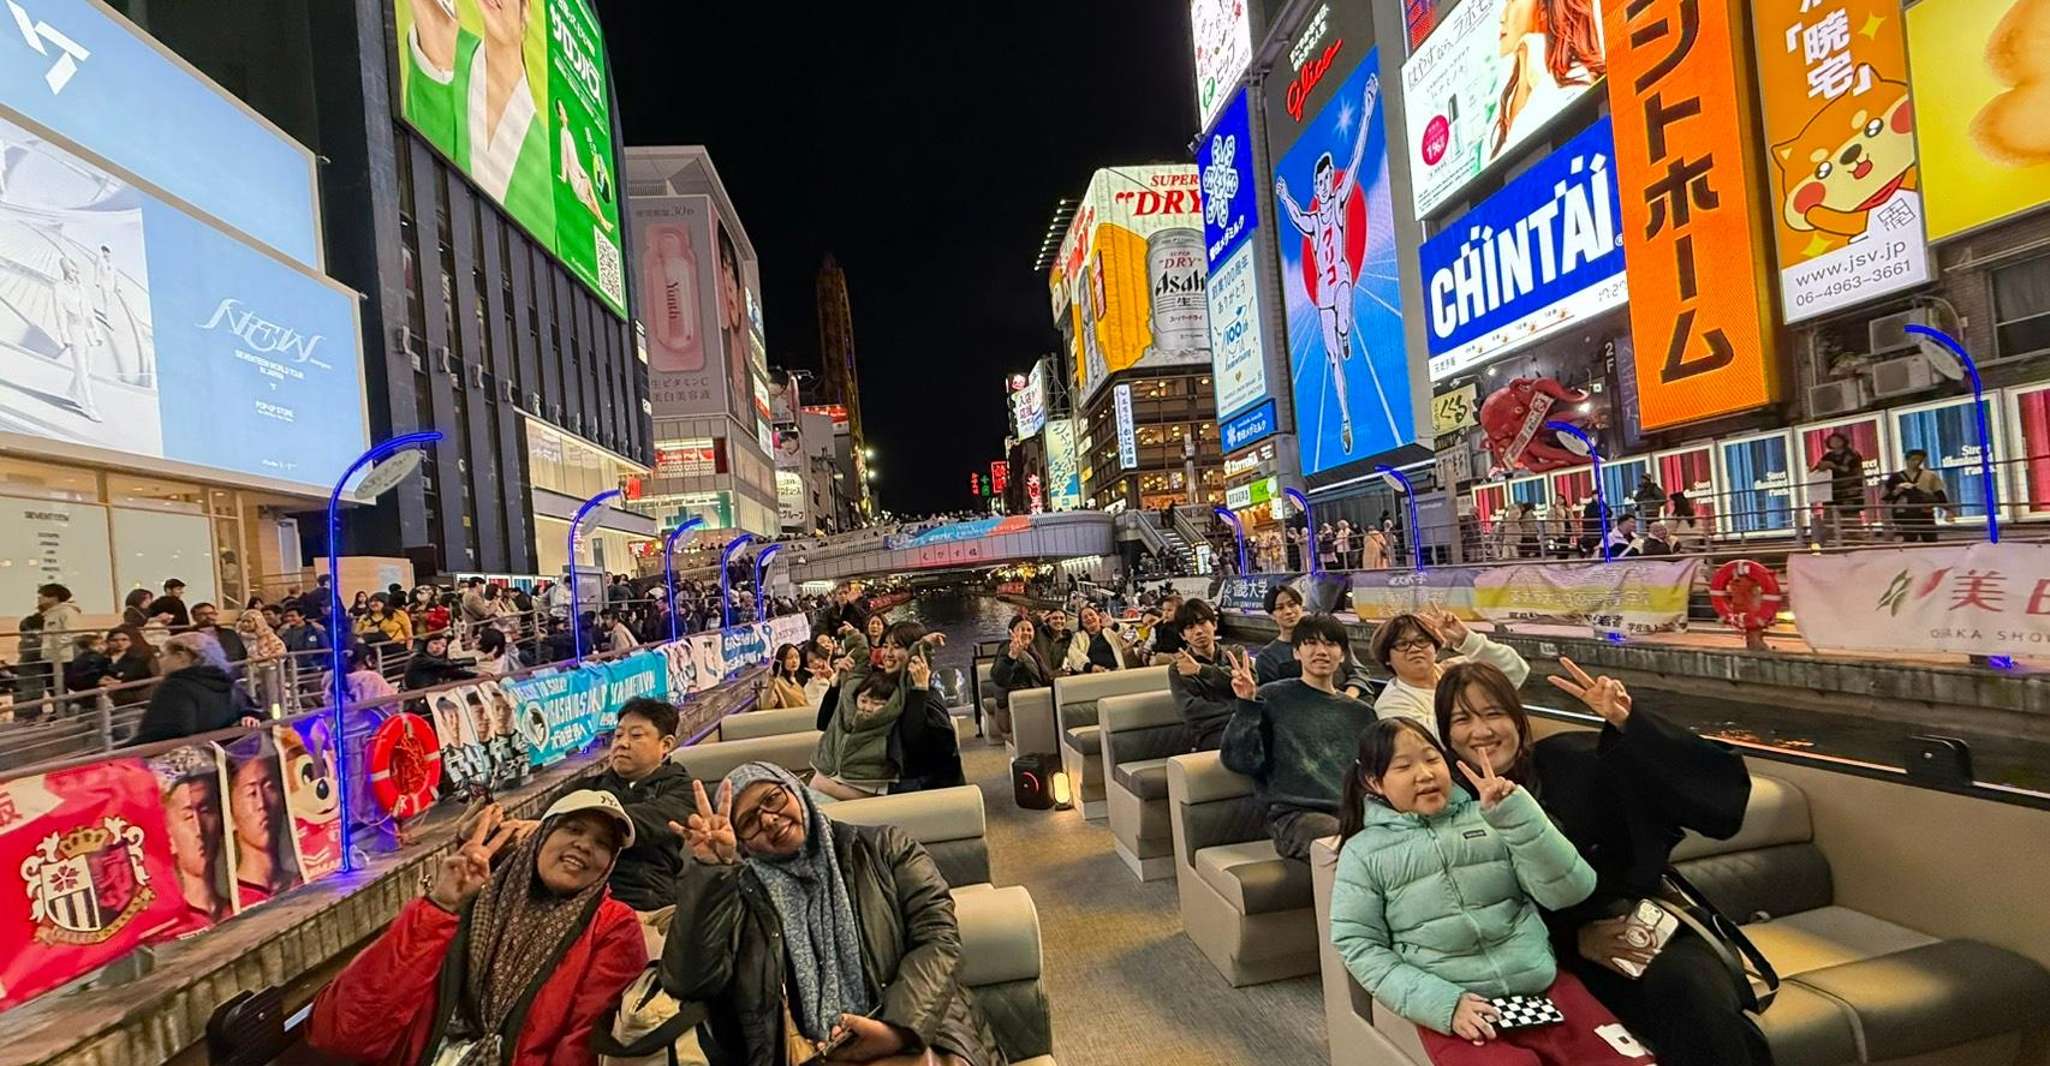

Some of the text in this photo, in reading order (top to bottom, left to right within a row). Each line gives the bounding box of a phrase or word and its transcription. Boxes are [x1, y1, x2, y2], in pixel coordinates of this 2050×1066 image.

[1151, 174, 1199, 187] SUPER
[1323, 227, 1337, 286] グリコ
[1796, 241, 1906, 287] www.jsv.jp
[1796, 260, 1911, 306] 06-4963-3661
